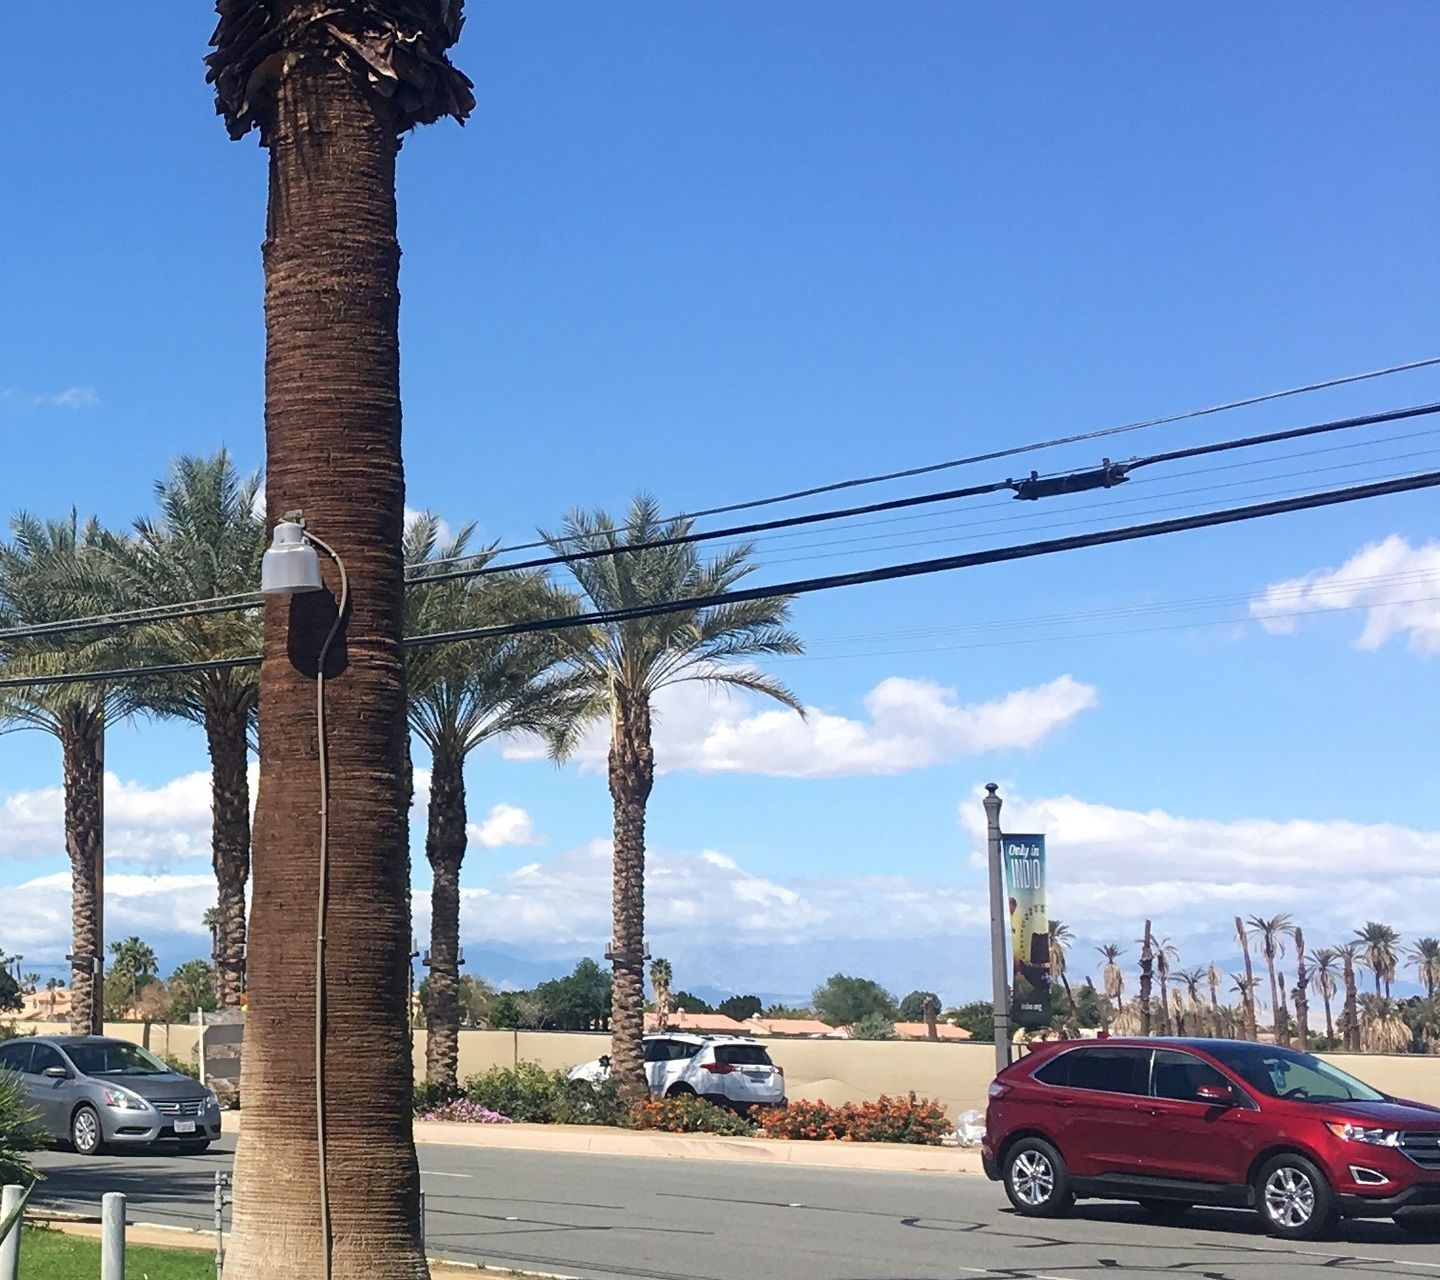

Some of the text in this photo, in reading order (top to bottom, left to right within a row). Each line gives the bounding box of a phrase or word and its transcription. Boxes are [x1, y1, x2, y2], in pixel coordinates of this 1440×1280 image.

[1009, 843, 1040, 859] Only in
[1011, 858, 1040, 890] INDIO
